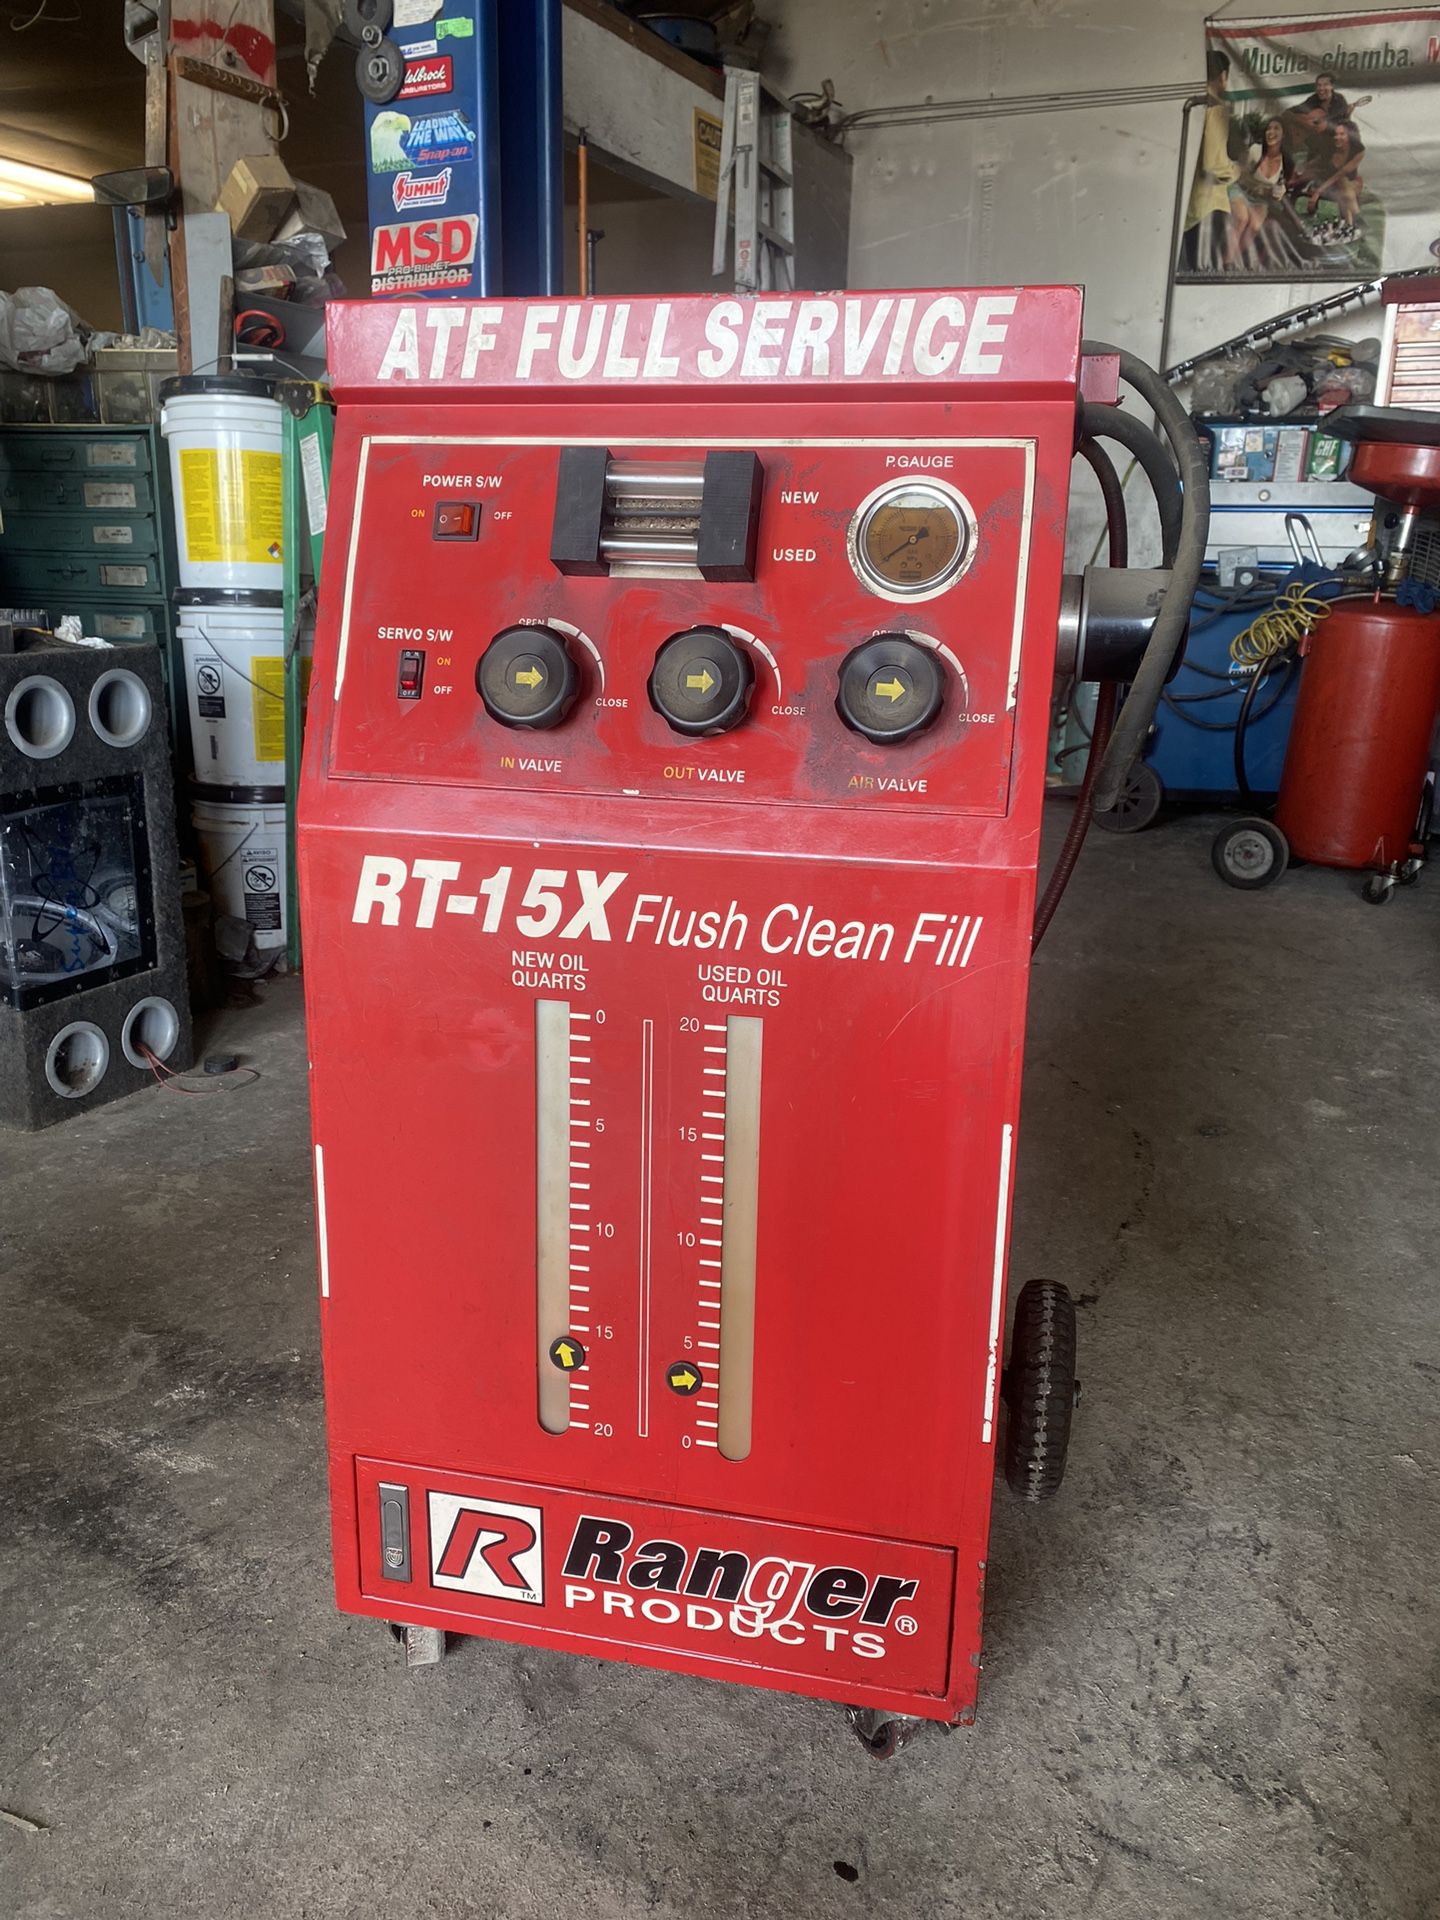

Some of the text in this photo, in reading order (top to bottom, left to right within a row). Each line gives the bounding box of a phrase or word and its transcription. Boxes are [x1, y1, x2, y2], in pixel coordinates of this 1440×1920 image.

[1241, 46, 1308, 75] Mucha
[1322, 42, 1414, 72] chamba.
[406, 124, 466, 147] THE WAY
[418, 146, 469, 161] Snap-on
[376, 220, 472, 273] MSD
[387, 262, 450, 275] PRO-BILLET
[372, 268, 472, 292] DISTRIBUTOR
[376, 296, 1018, 380] ATF FULL SERVICE
[885, 455, 954, 468] P.GAUGE
[423, 474, 503, 488] POWER S/W
[781, 491, 820, 504] NEW
[411, 508, 426, 518] ON
[493, 511, 514, 521] OFF
[773, 548, 816, 562] USED
[377, 626, 453, 642] SERVO S/W
[436, 656, 451, 666] ON
[433, 685, 453, 695] OFF
[595, 697, 628, 708] CLOSE
[770, 703, 808, 718] CLOSE
[957, 711, 996, 725] CLOSE
[500, 756, 562, 773] IN VALVE
[663, 766, 745, 783] OUT VALVE
[847, 775, 928, 793] AIR VALVE
[351, 854, 984, 968] RT-15X Flush Clean Fill
[512, 950, 589, 972] NEW OIL
[512, 967, 589, 991] QUARTS
[698, 964, 788, 991] USED OIL
[702, 983, 783, 1007] QUARTS
[596, 1009, 606, 1024] 0
[679, 1016, 700, 1033] 20
[595, 1118, 605, 1132] 5
[679, 1127, 697, 1142] 15
[596, 1222, 614, 1238] 10
[677, 1232, 695, 1247] 10
[596, 1325, 613, 1339] 15
[684, 1335, 693, 1349] 5
[594, 1422, 613, 1437] 20
[682, 1435, 691, 1449] 0
[561, 1514, 919, 1625] Ranger
[565, 1584, 888, 1658] PRODUCTS
